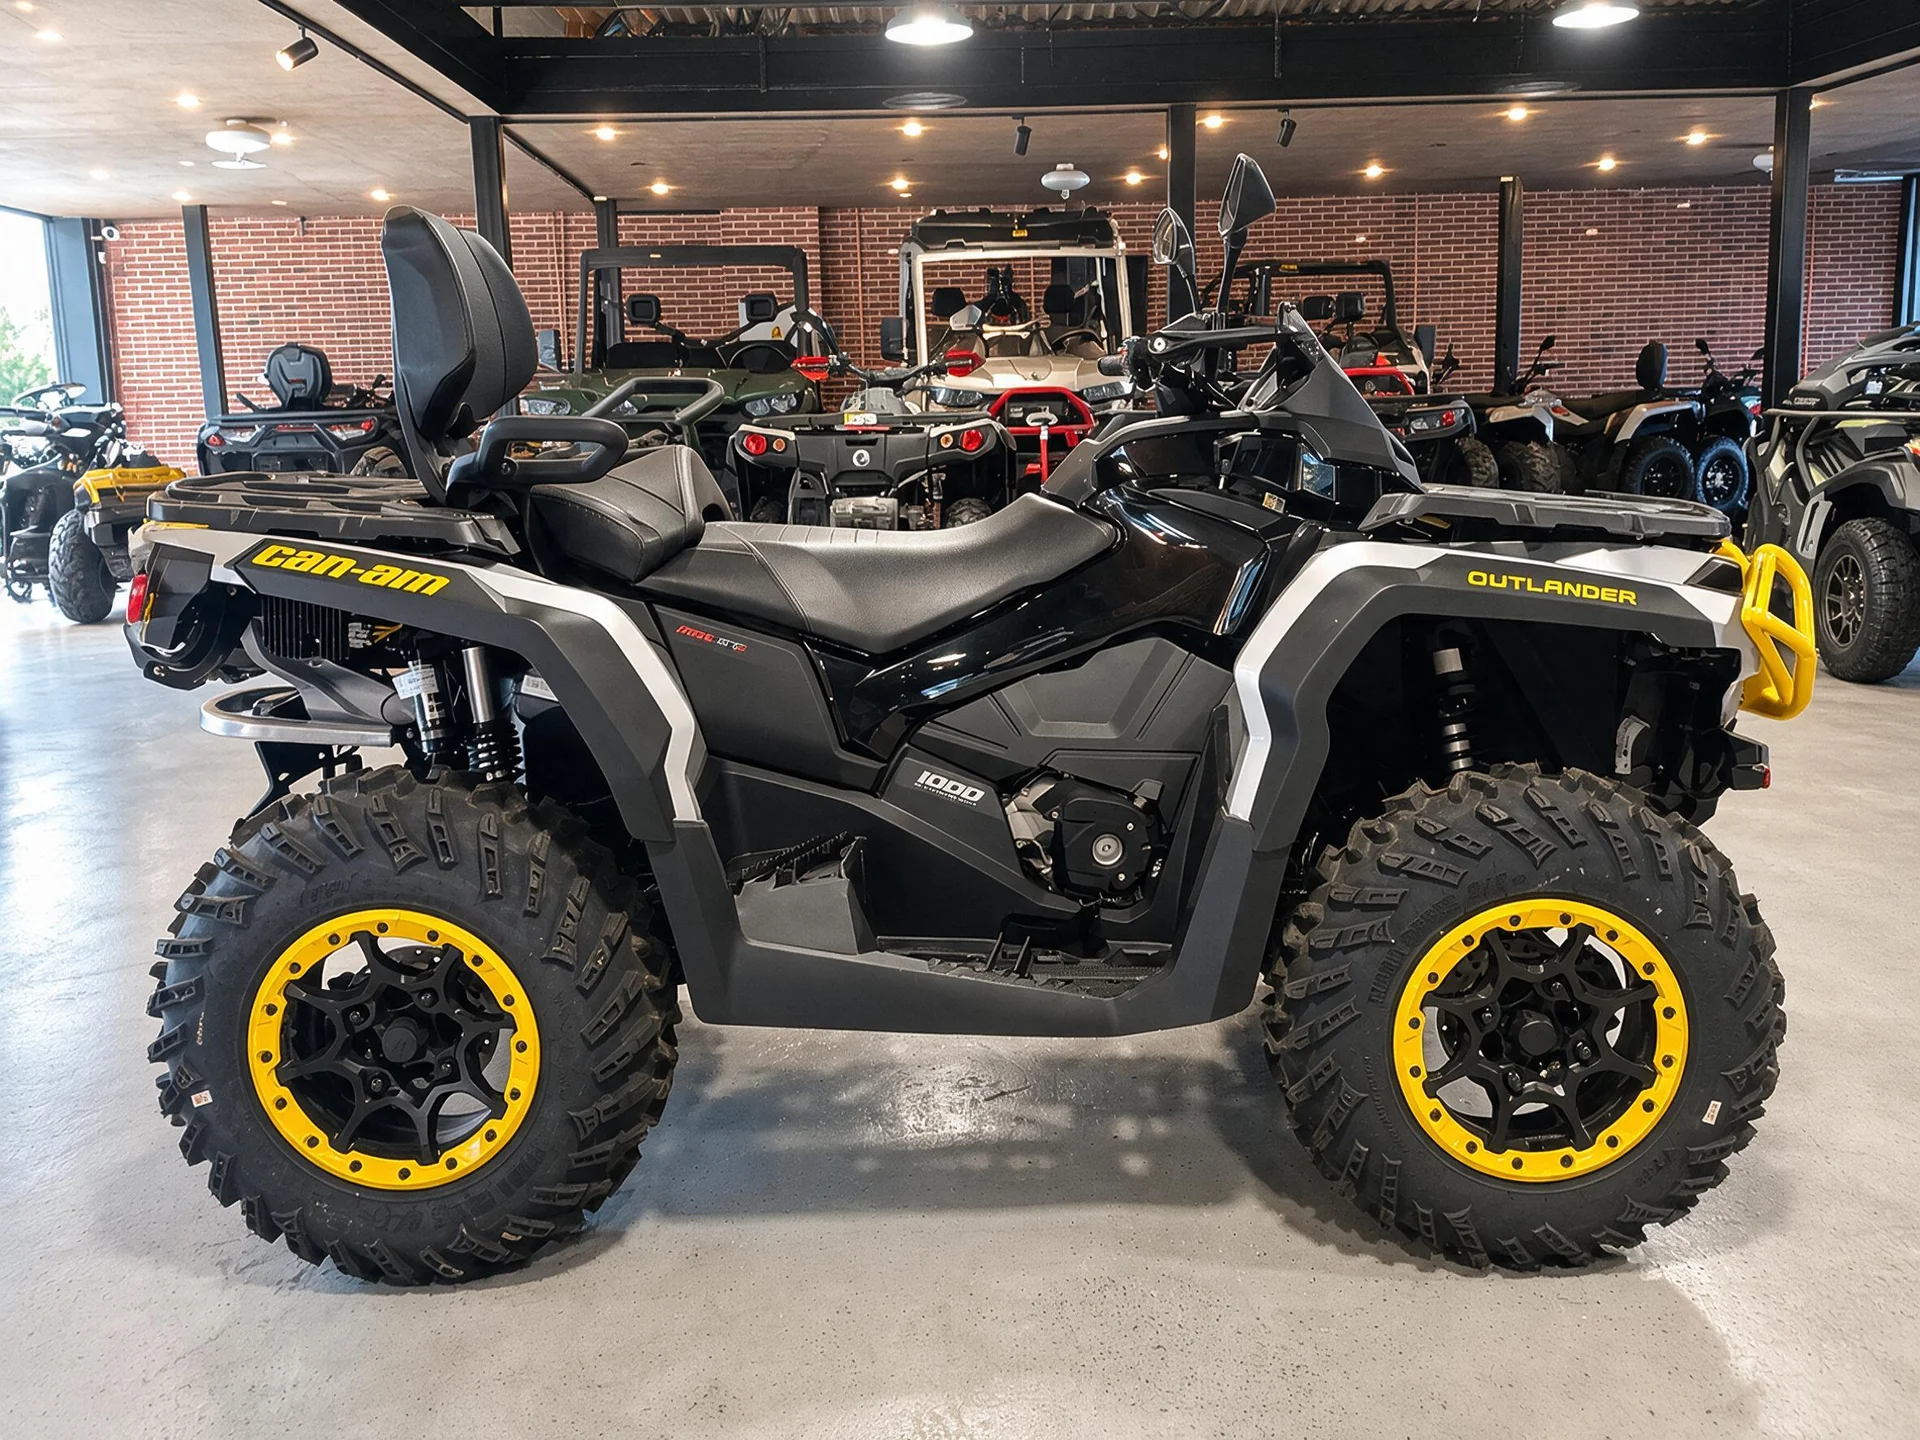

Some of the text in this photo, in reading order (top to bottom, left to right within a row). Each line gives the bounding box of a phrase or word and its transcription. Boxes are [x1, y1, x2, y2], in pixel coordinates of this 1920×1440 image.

[251, 544, 450, 597] can-am
[1467, 570, 1638, 606] OUTLANDER
[916, 770, 986, 802] 1000
